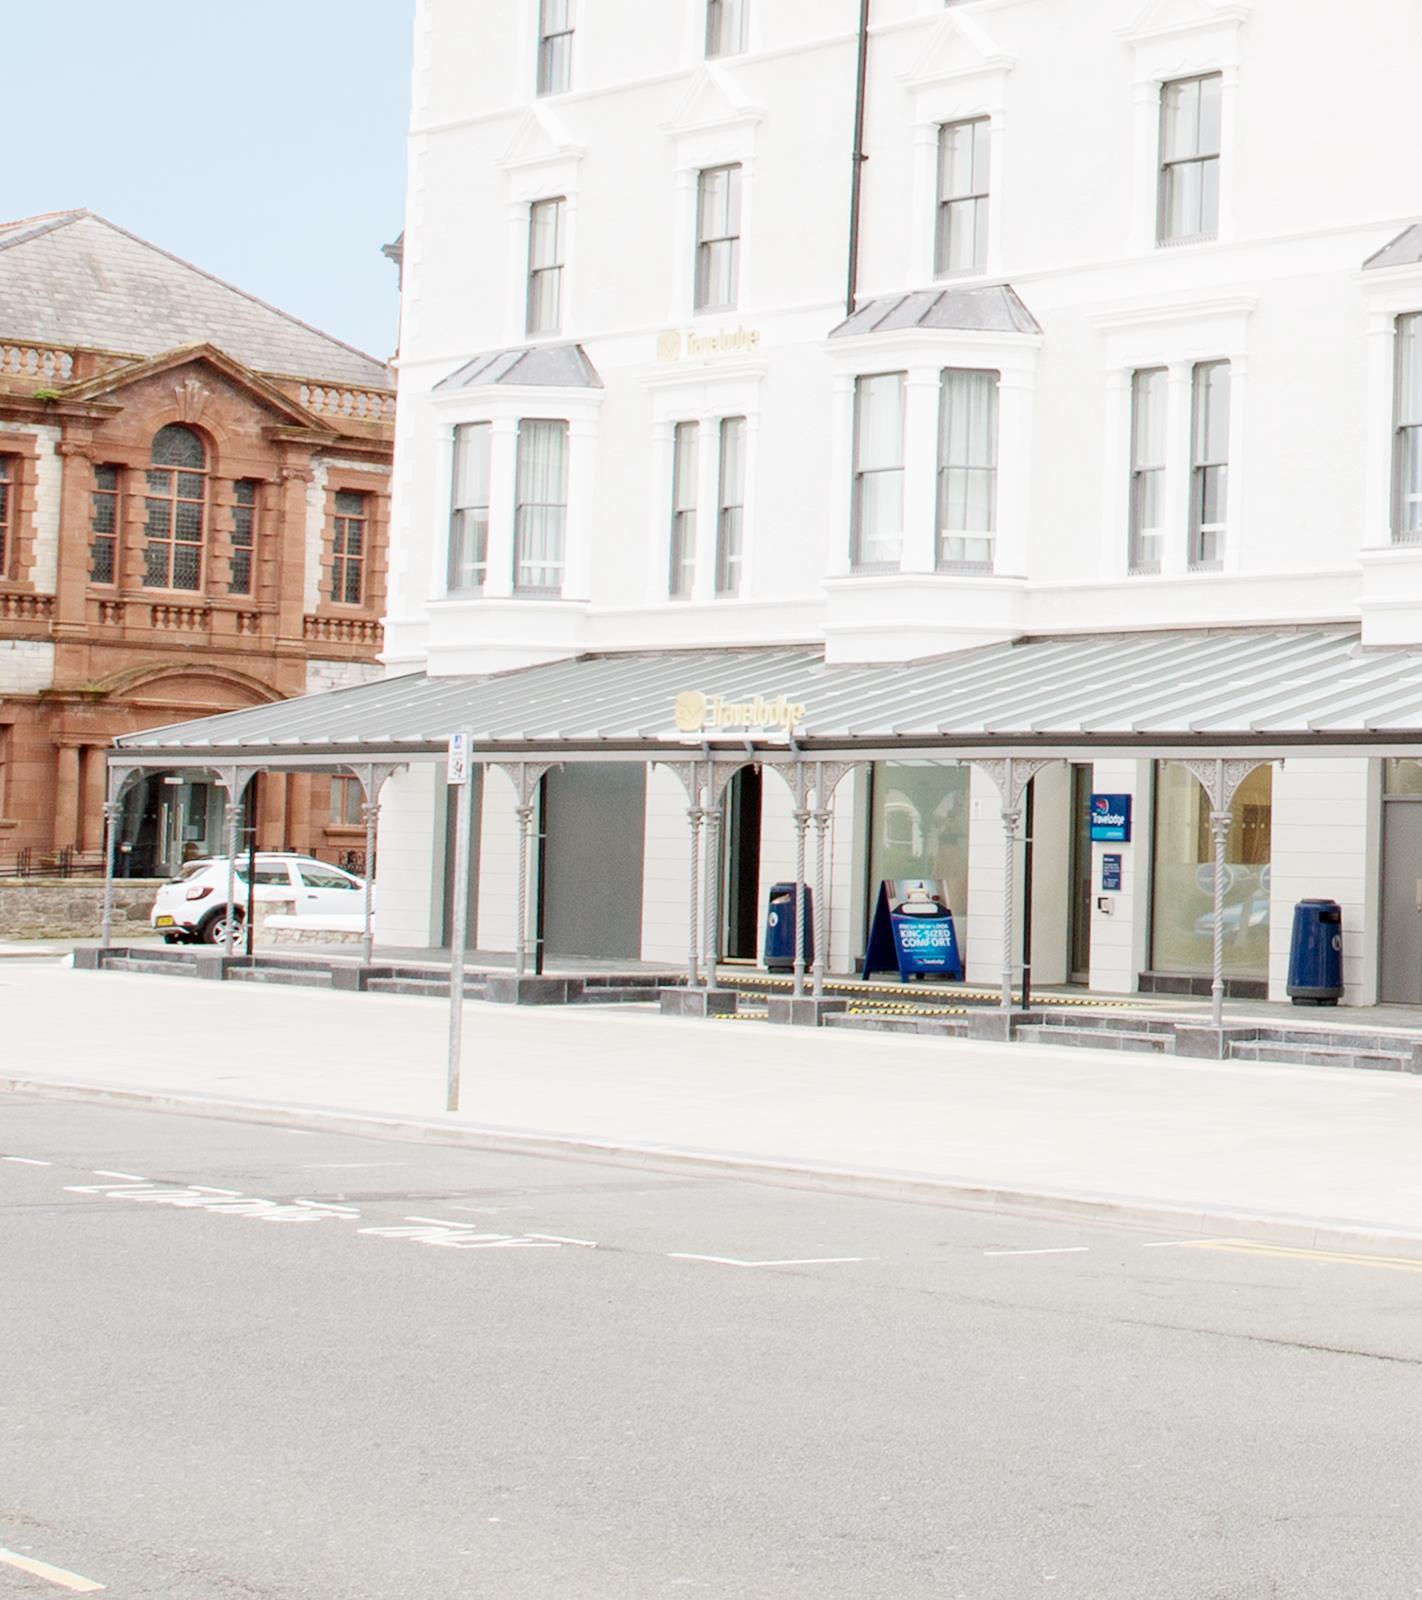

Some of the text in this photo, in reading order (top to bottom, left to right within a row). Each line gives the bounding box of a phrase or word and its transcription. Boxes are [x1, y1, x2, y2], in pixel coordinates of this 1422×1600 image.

[710, 694, 806, 733] Travelodge
[1092, 812, 1126, 827] Travelodge
[901, 937, 952, 948] COMFORT
